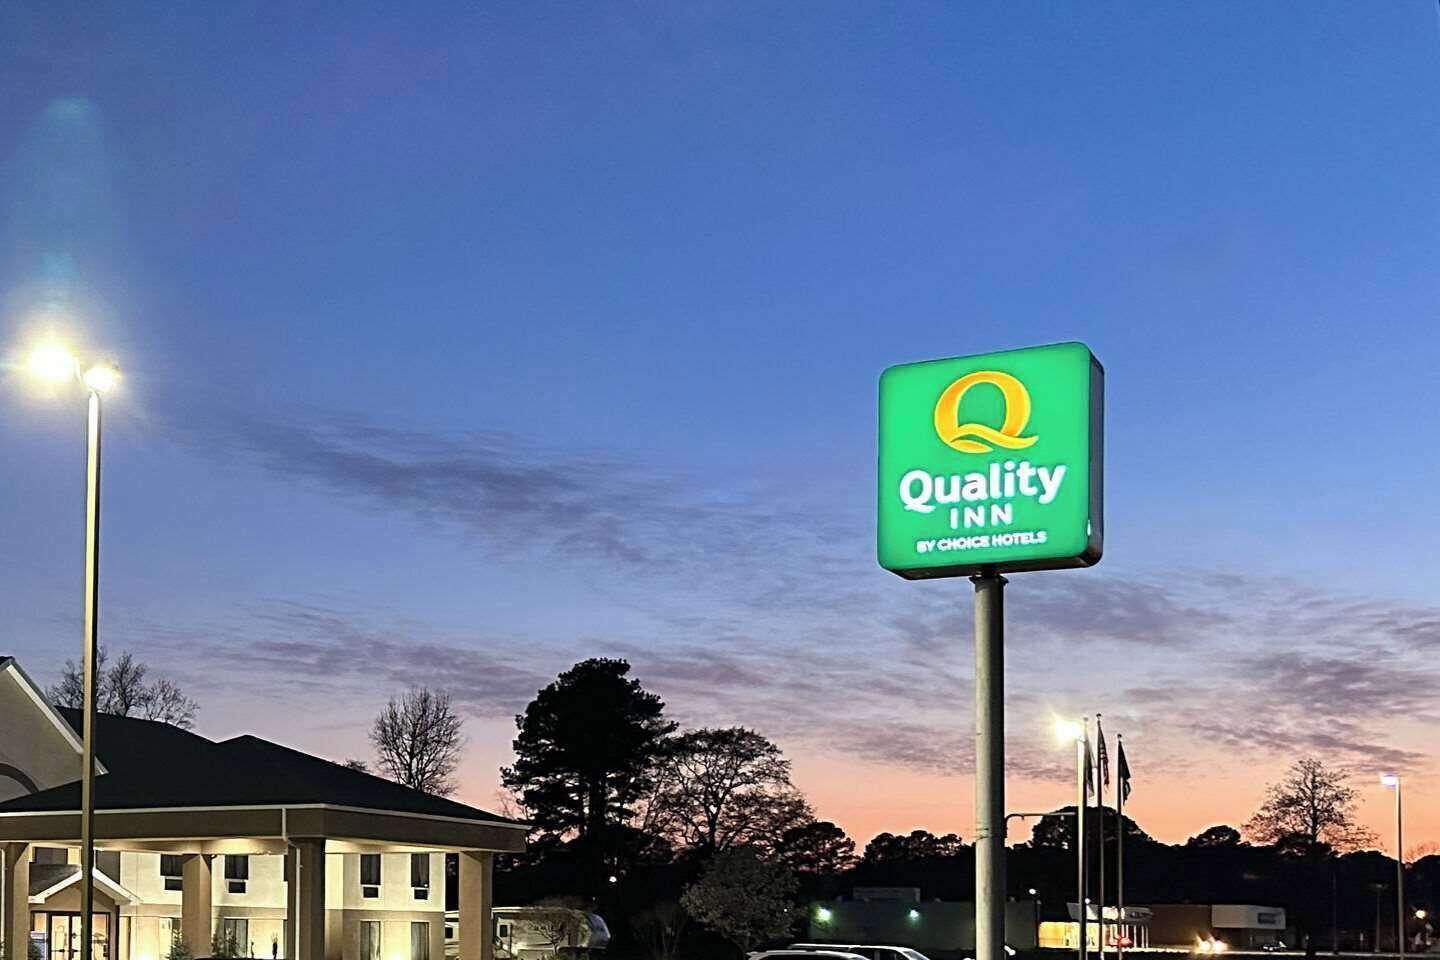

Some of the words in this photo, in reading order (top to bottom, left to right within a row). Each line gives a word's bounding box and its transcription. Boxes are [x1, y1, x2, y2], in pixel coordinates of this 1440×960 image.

[933, 370, 1039, 454] Q
[899, 461, 1067, 513] Quality
[950, 503, 1013, 530] INN
[916, 540, 936, 553] BY
[937, 536, 990, 551] CHOICE
[991, 531, 1048, 547] HOTELS
